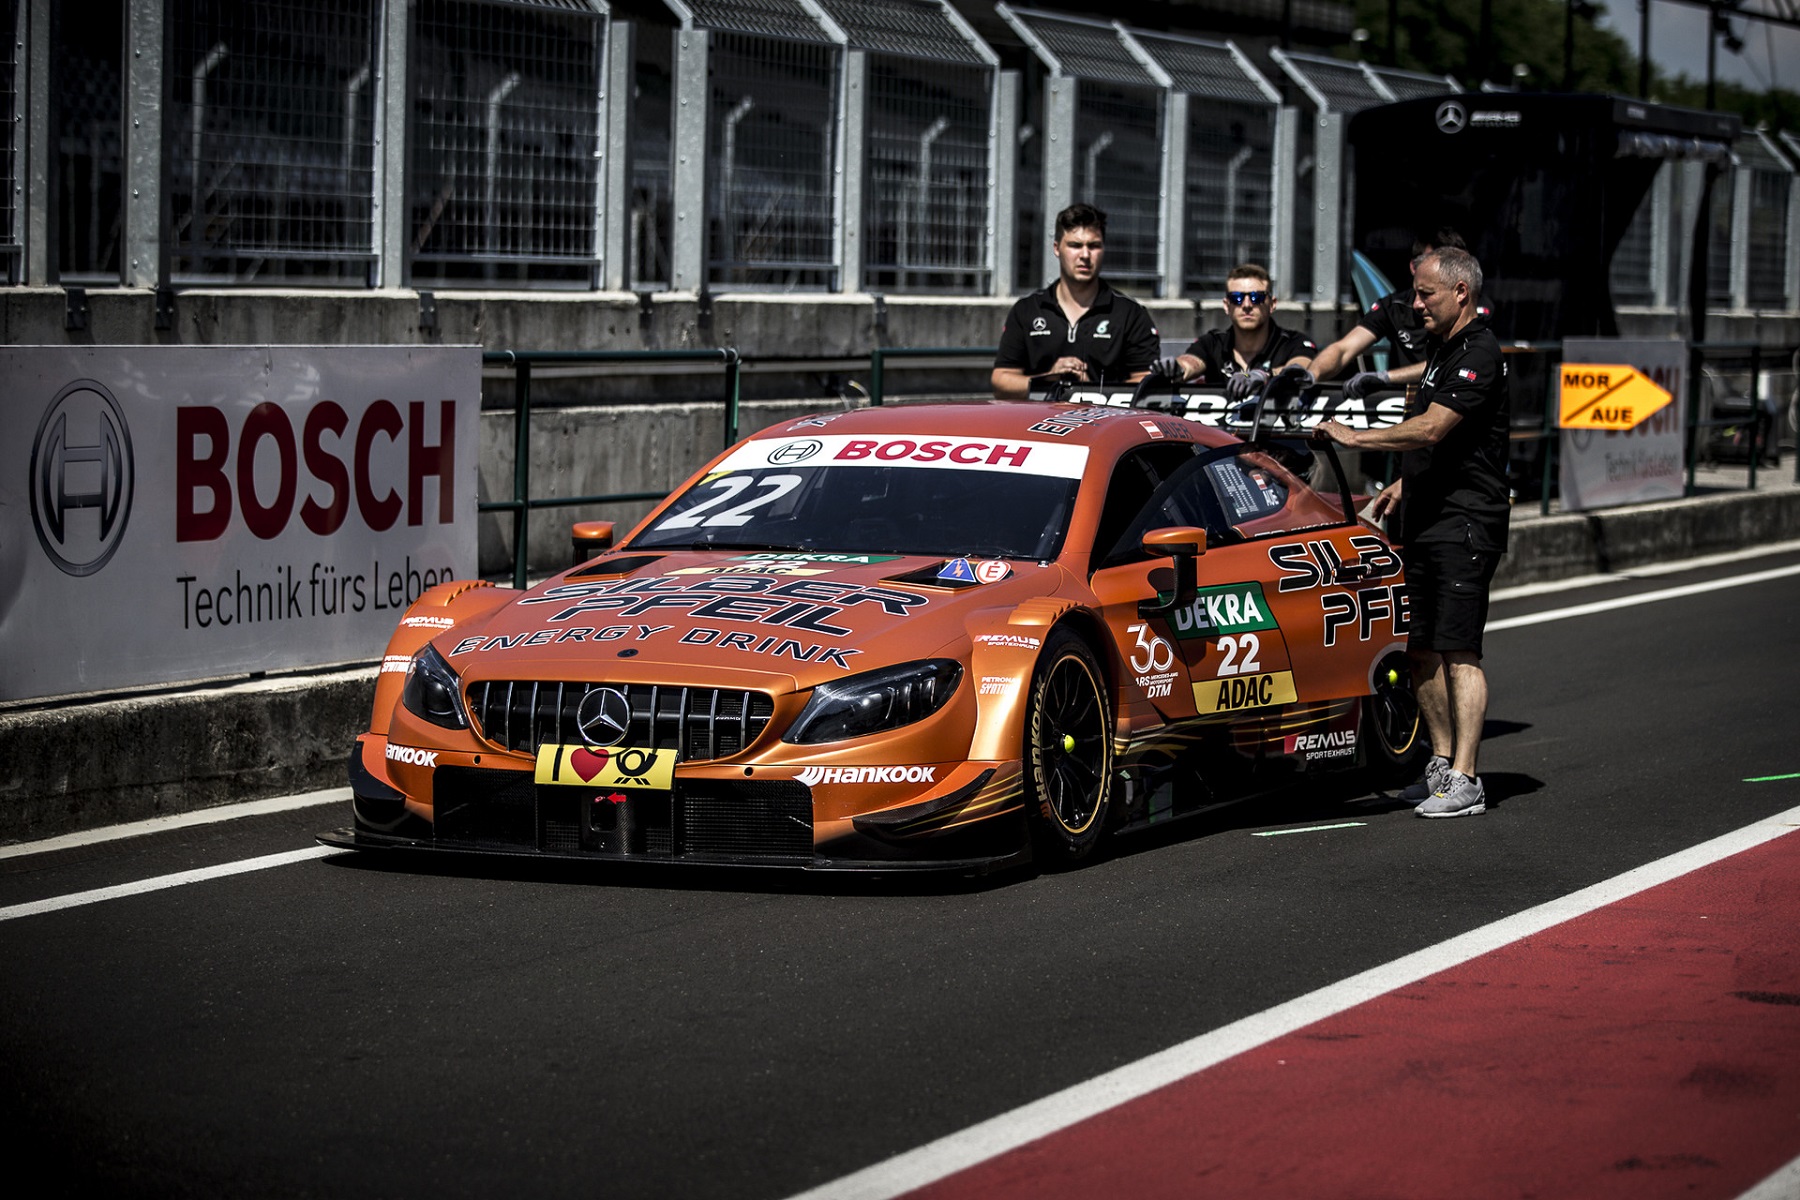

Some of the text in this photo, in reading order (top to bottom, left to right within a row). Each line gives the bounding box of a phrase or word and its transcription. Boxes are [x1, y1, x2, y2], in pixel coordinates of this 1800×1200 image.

[1563, 373, 1610, 389] MOR
[1590, 407, 1633, 423] AUE
[176, 399, 456, 543] BOSCH
[833, 440, 1032, 467] BOSCH
[654, 473, 803, 531] 22
[703, 567, 794, 575] ADAC
[745, 553, 870, 564] DEKRA
[176, 565, 303, 630] Technik
[309, 562, 367, 616] fürs
[517, 576, 930, 617] SILBER
[1174, 591, 1264, 631] DEKRA
[546, 593, 852, 636] PFEIL
[448, 624, 864, 670] ENERGY DRINK
[977, 634, 1040, 646] REMUS
[1126, 623, 1174, 674] 30
[1216, 633, 1261, 677] 22
[1147, 683, 1173, 699] DTM
[1215, 675, 1273, 711] ADAC
[1294, 730, 1356, 751] REMUS
[1306, 747, 1356, 760] SPORTEXHAUST
